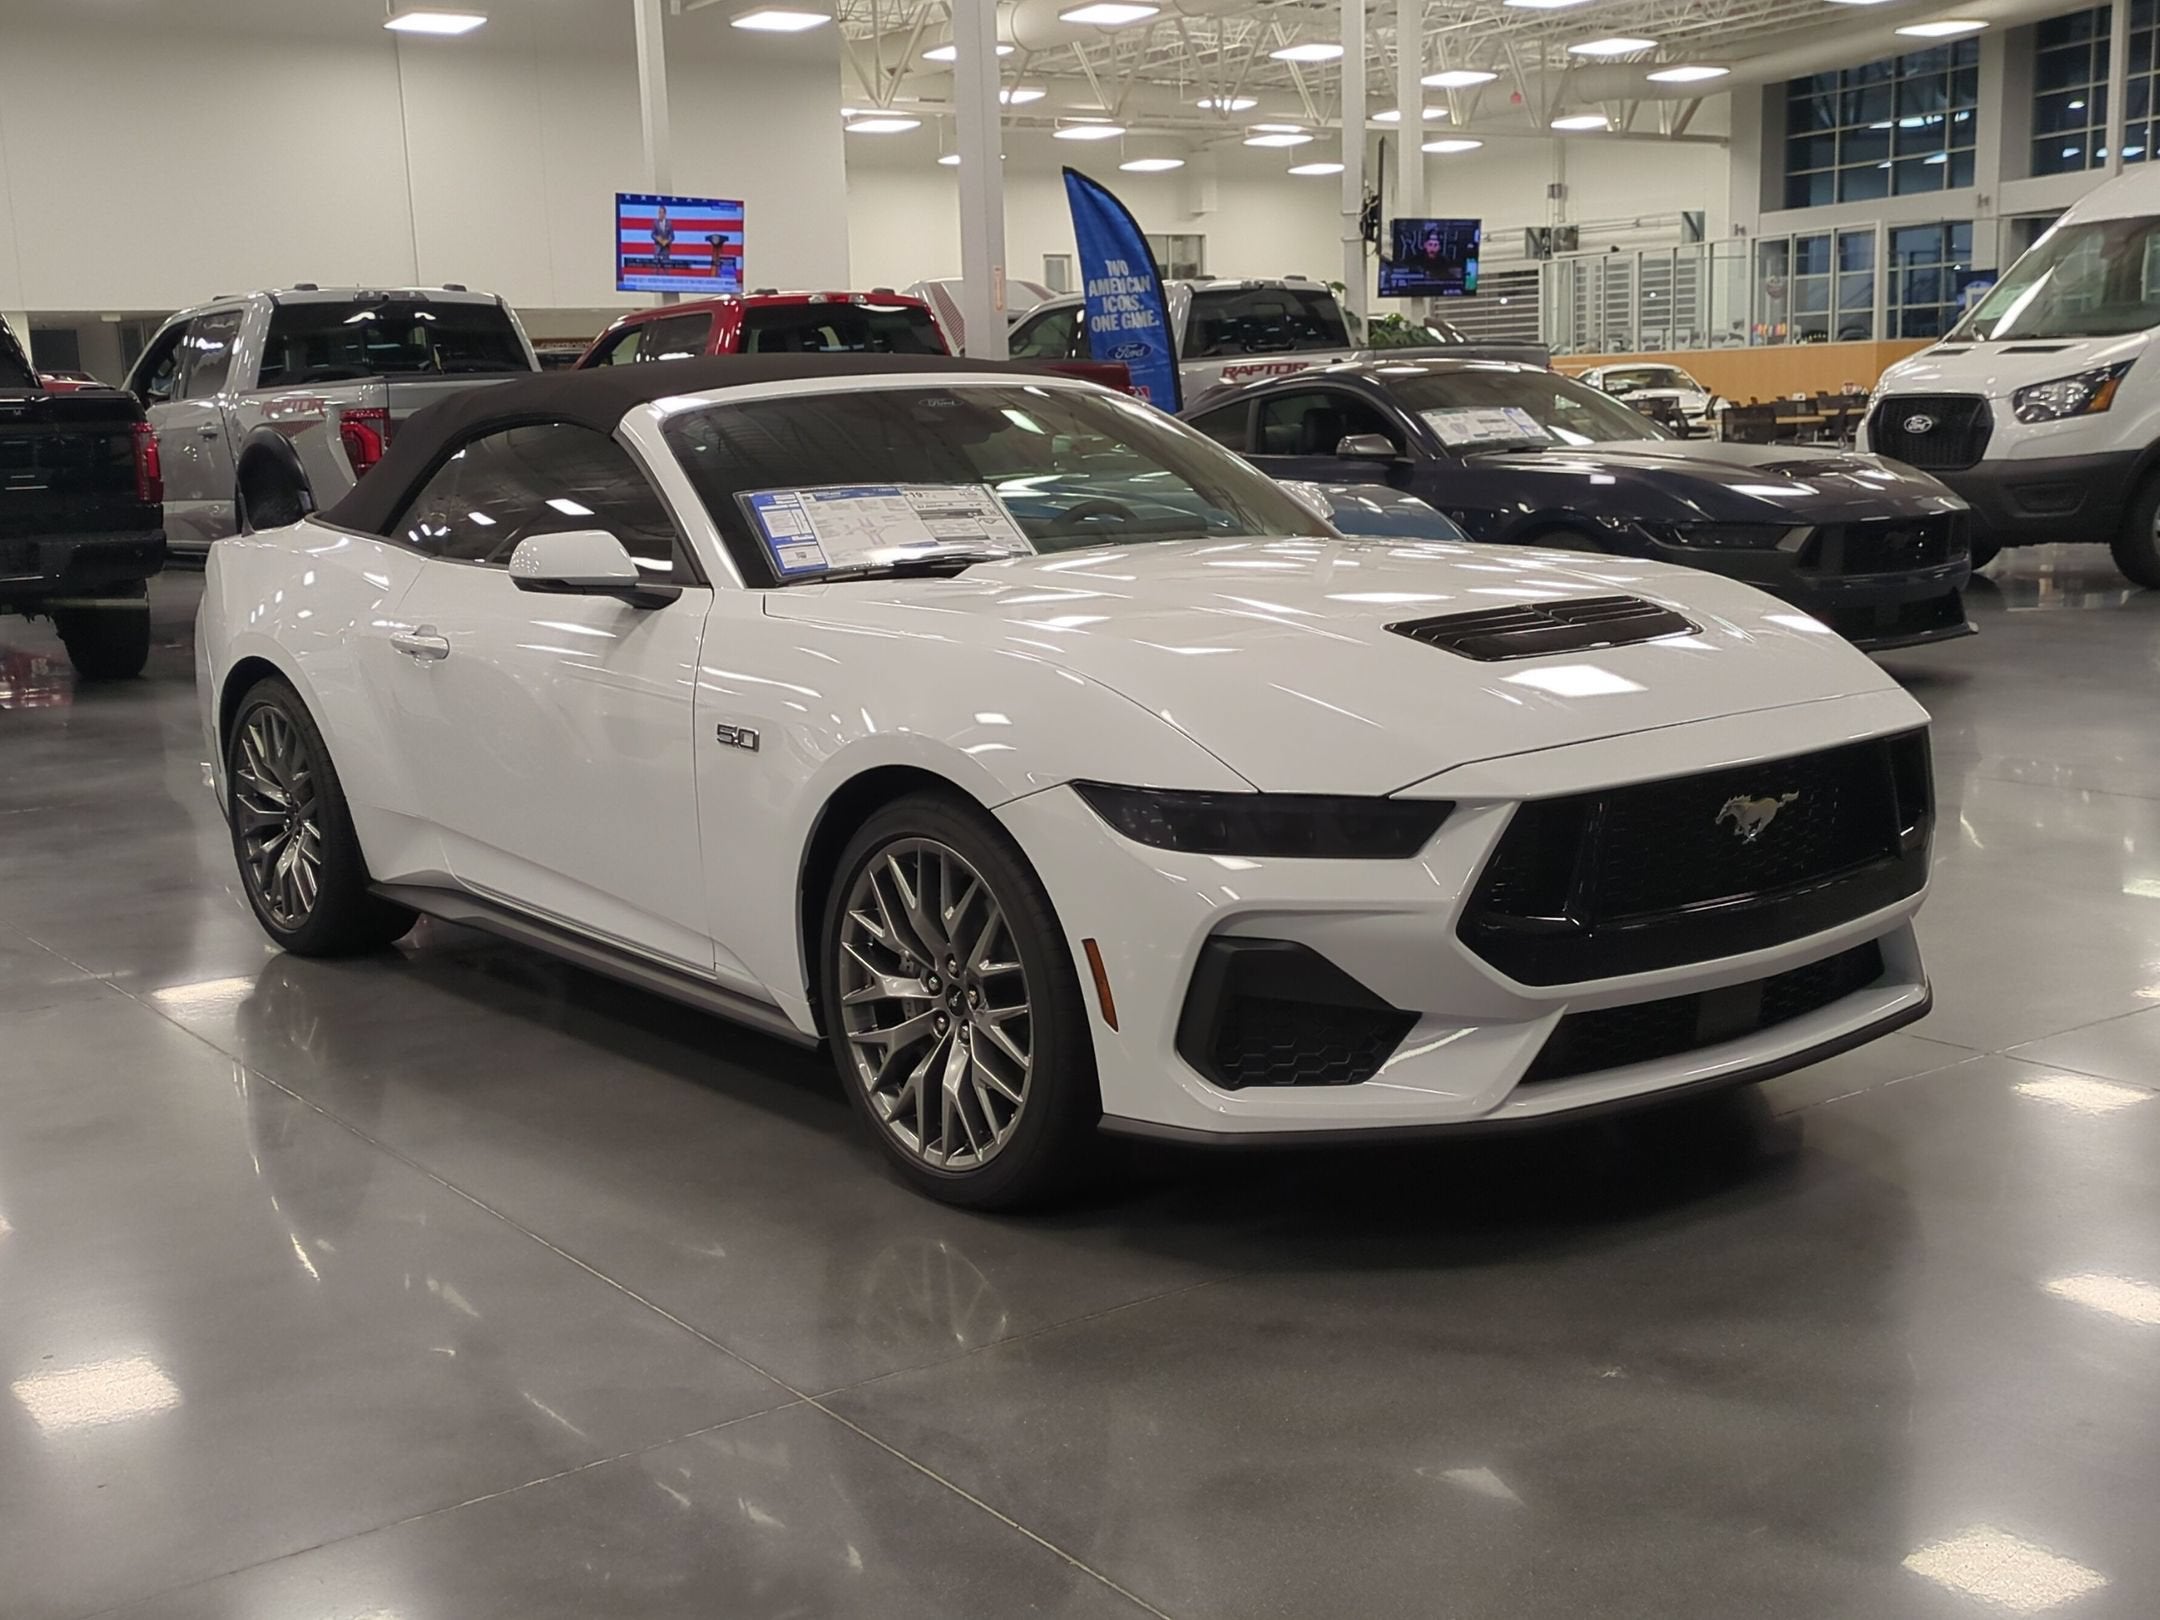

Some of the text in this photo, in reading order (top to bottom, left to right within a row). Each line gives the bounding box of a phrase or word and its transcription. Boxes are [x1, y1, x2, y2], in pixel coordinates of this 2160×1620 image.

[1104, 260, 1129, 277] TWO
[1089, 275, 1151, 297] AMERICAN
[1102, 295, 1144, 313] ICONS.
[1091, 310, 1160, 332] ONE GAME.
[1113, 343, 1147, 359] Ford
[1221, 362, 1309, 381] RAPTOR
[717, 724, 760, 752] 5.0
